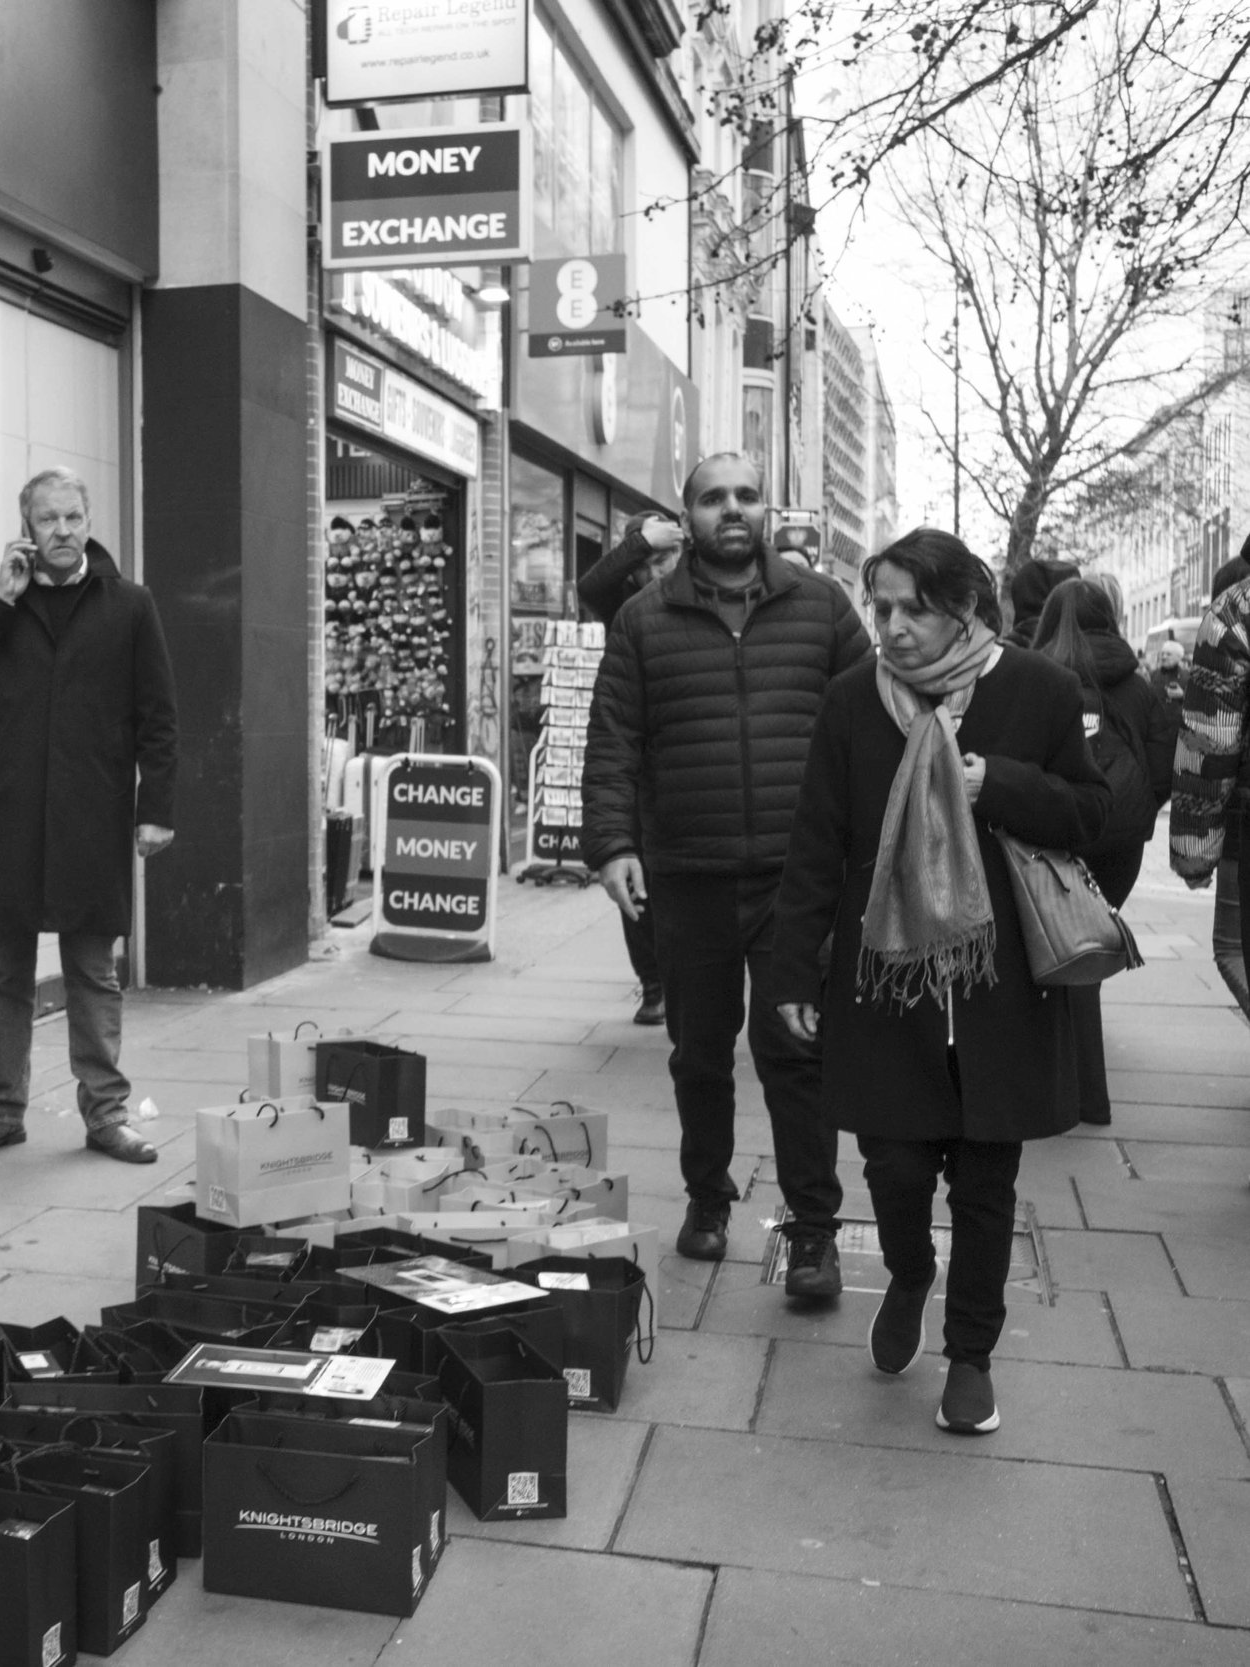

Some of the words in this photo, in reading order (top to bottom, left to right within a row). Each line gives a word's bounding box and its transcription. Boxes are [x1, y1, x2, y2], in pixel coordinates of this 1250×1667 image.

[378, 2, 438, 25] Repair
[367, 146, 482, 178] MONEY
[342, 213, 507, 247] EXCHANGE
[393, 782, 484, 807] CHANGE
[396, 837, 478, 861] MONEY
[538, 834, 582, 851] CHAN
[388, 889, 480, 916] CHANGE
[239, 1508, 378, 1538] KNIGHTSBRIDGE
[279, 1531, 335, 1545] LONDON
